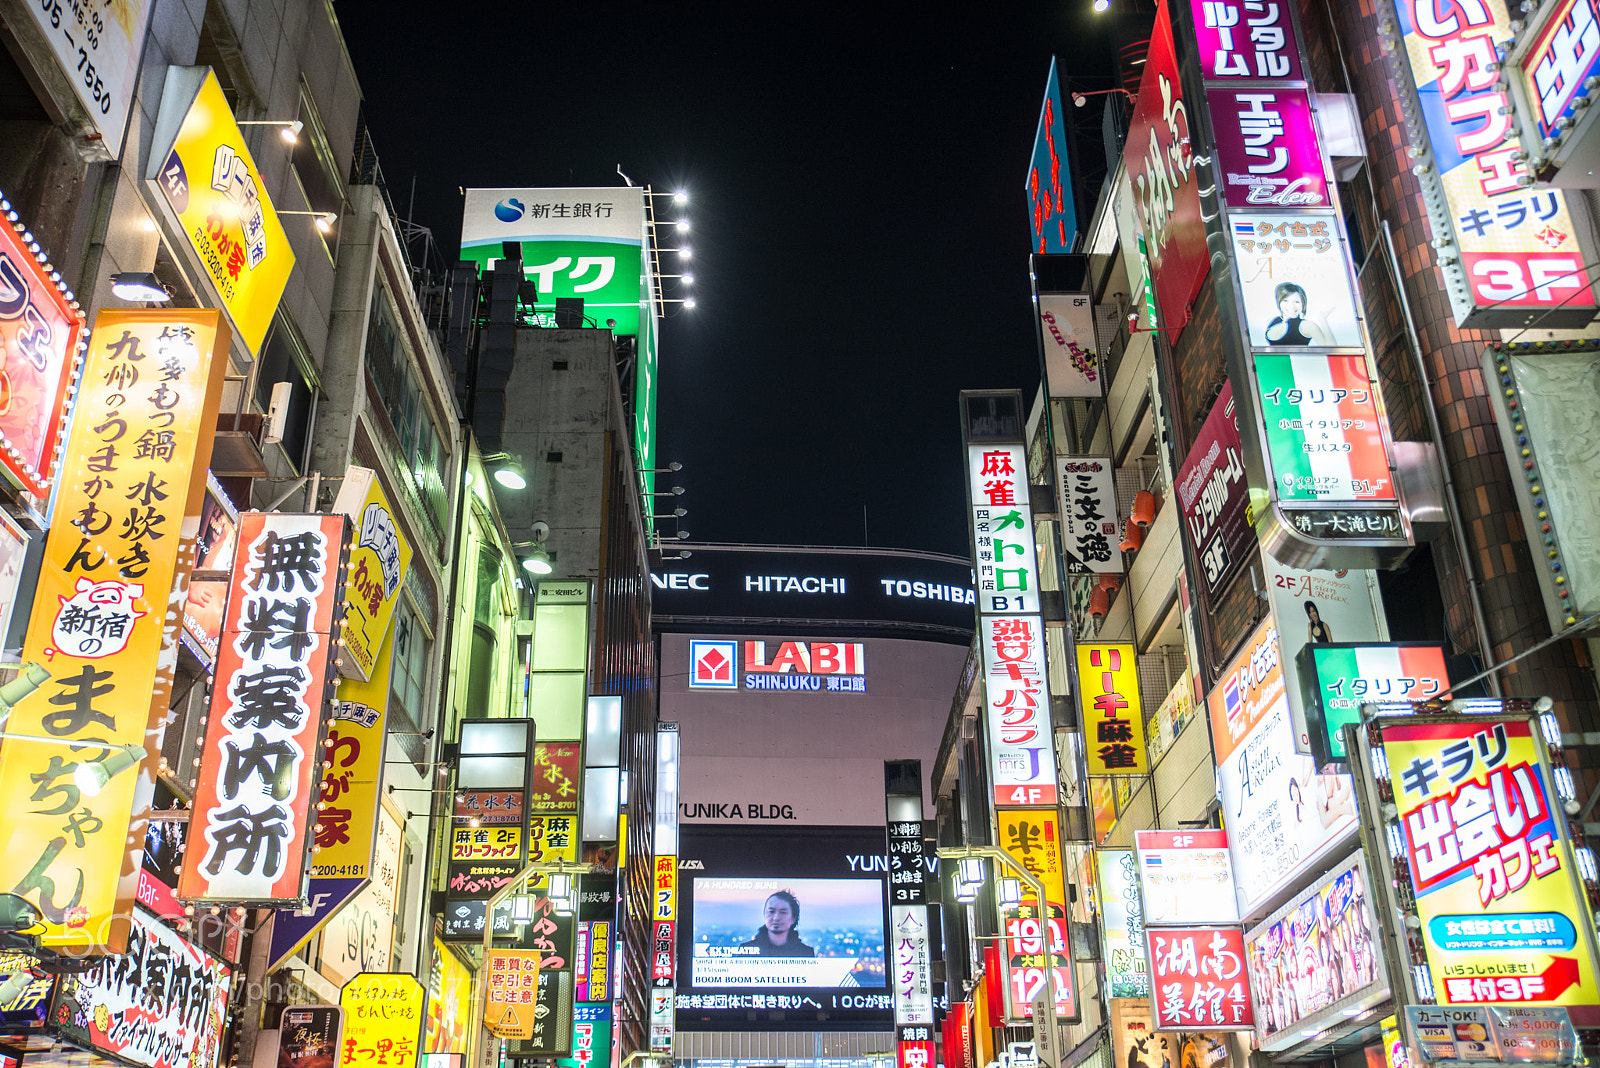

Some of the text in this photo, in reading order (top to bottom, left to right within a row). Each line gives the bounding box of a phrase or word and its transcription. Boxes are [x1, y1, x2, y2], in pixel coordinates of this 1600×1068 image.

[1202, 1, 1253, 77] ルーム
[1244, 0, 1291, 77] ンタル
[1235, 93, 1290, 175] エデン
[165, 164, 188, 198] 4F
[1245, 178, 1323, 206] Eden
[531, 202, 614, 219] 新生銀行
[1460, 191, 1559, 237] キラリ
[1257, 221, 1330, 237] タイ古式
[207, 213, 246, 282] わが家
[1237, 238, 1332, 254] マッサージ
[487, 256, 616, 294] イク
[1472, 258, 1582, 301] 3F
[1072, 298, 1088, 308] 5F
[1264, 387, 1370, 405] イタリアン
[1278, 418, 1366, 430] 小皿イタリアン
[63, 331, 146, 574] 九州のうまかもん
[1302, 442, 1352, 453] 生パスタ
[980, 450, 1016, 507] 麻雀
[1350, 480, 1371, 493] B1
[1188, 445, 1244, 550] レンタルルーム
[117, 471, 170, 579] 水炊き
[1294, 515, 1400, 533] 第一大滝ビル
[367, 505, 399, 595] リーチ麻雀
[976, 509, 995, 591] 四名様専門店
[1204, 535, 1226, 584] 3F
[354, 556, 384, 618] わが家
[650, 572, 710, 591] NEC
[745, 575, 846, 594] HITACHI
[1274, 574, 1296, 589] 2F
[541, 588, 584, 597] 第二安田ビル
[880, 579, 976, 605] TOSHIBA
[991, 595, 1025, 611] B1
[59, 604, 131, 639] 新宿
[79, 638, 103, 656] の
[744, 640, 865, 675] LABI
[745, 674, 866, 692] SHINJUKU 東口館
[990, 618, 1043, 745] 熟女キャバクラ
[1327, 677, 1440, 697] イタリアン
[205, 531, 322, 878] 無料案内所
[1089, 649, 1138, 770] リーチ麻雀
[1013, 747, 1047, 782] J
[1400, 723, 1508, 800] キラリ
[465, 794, 518, 810] 花水木
[1010, 786, 1042, 804] 4F
[747, 804, 798, 820] BLDG.
[546, 817, 570, 848] 麻雀
[890, 823, 921, 836] 小料理
[1407, 766, 1541, 883] 出会い
[455, 829, 516, 843] 麻雀 2F
[1172, 835, 1194, 848] 2F
[454, 843, 519, 858] スリーファイブ
[1473, 832, 1560, 909] カフェ
[656, 857, 673, 918] 麻雀ブル
[896, 889, 921, 900] 3F
[1445, 918, 1556, 936] 女性は全て無料!
[656, 924, 672, 967] 居酒屋
[492, 957, 535, 971] 悪質な
[1155, 930, 1242, 981] 湖南
[898, 937, 915, 1000] バンタイ
[1444, 962, 1536, 976] いらっしゃいませ!
[491, 973, 534, 988] 客引き
[656, 978, 670, 987] 4F
[695, 976, 807, 984] BOOM BOOM SATELLITES
[1446, 977, 1545, 1001] 受付3F
[490, 989, 533, 1004] に注意
[1161, 980, 1226, 1025] 菜館
[907, 1014, 921, 1022] 3F
[1418, 1010, 1477, 1023] カードOK!
[1508, 1008, 1548, 1018] お試しコース
[532, 1022, 545, 1048] 新風
[902, 1027, 928, 1041] 焼肉
[1424, 1029, 1445, 1037] VISA
